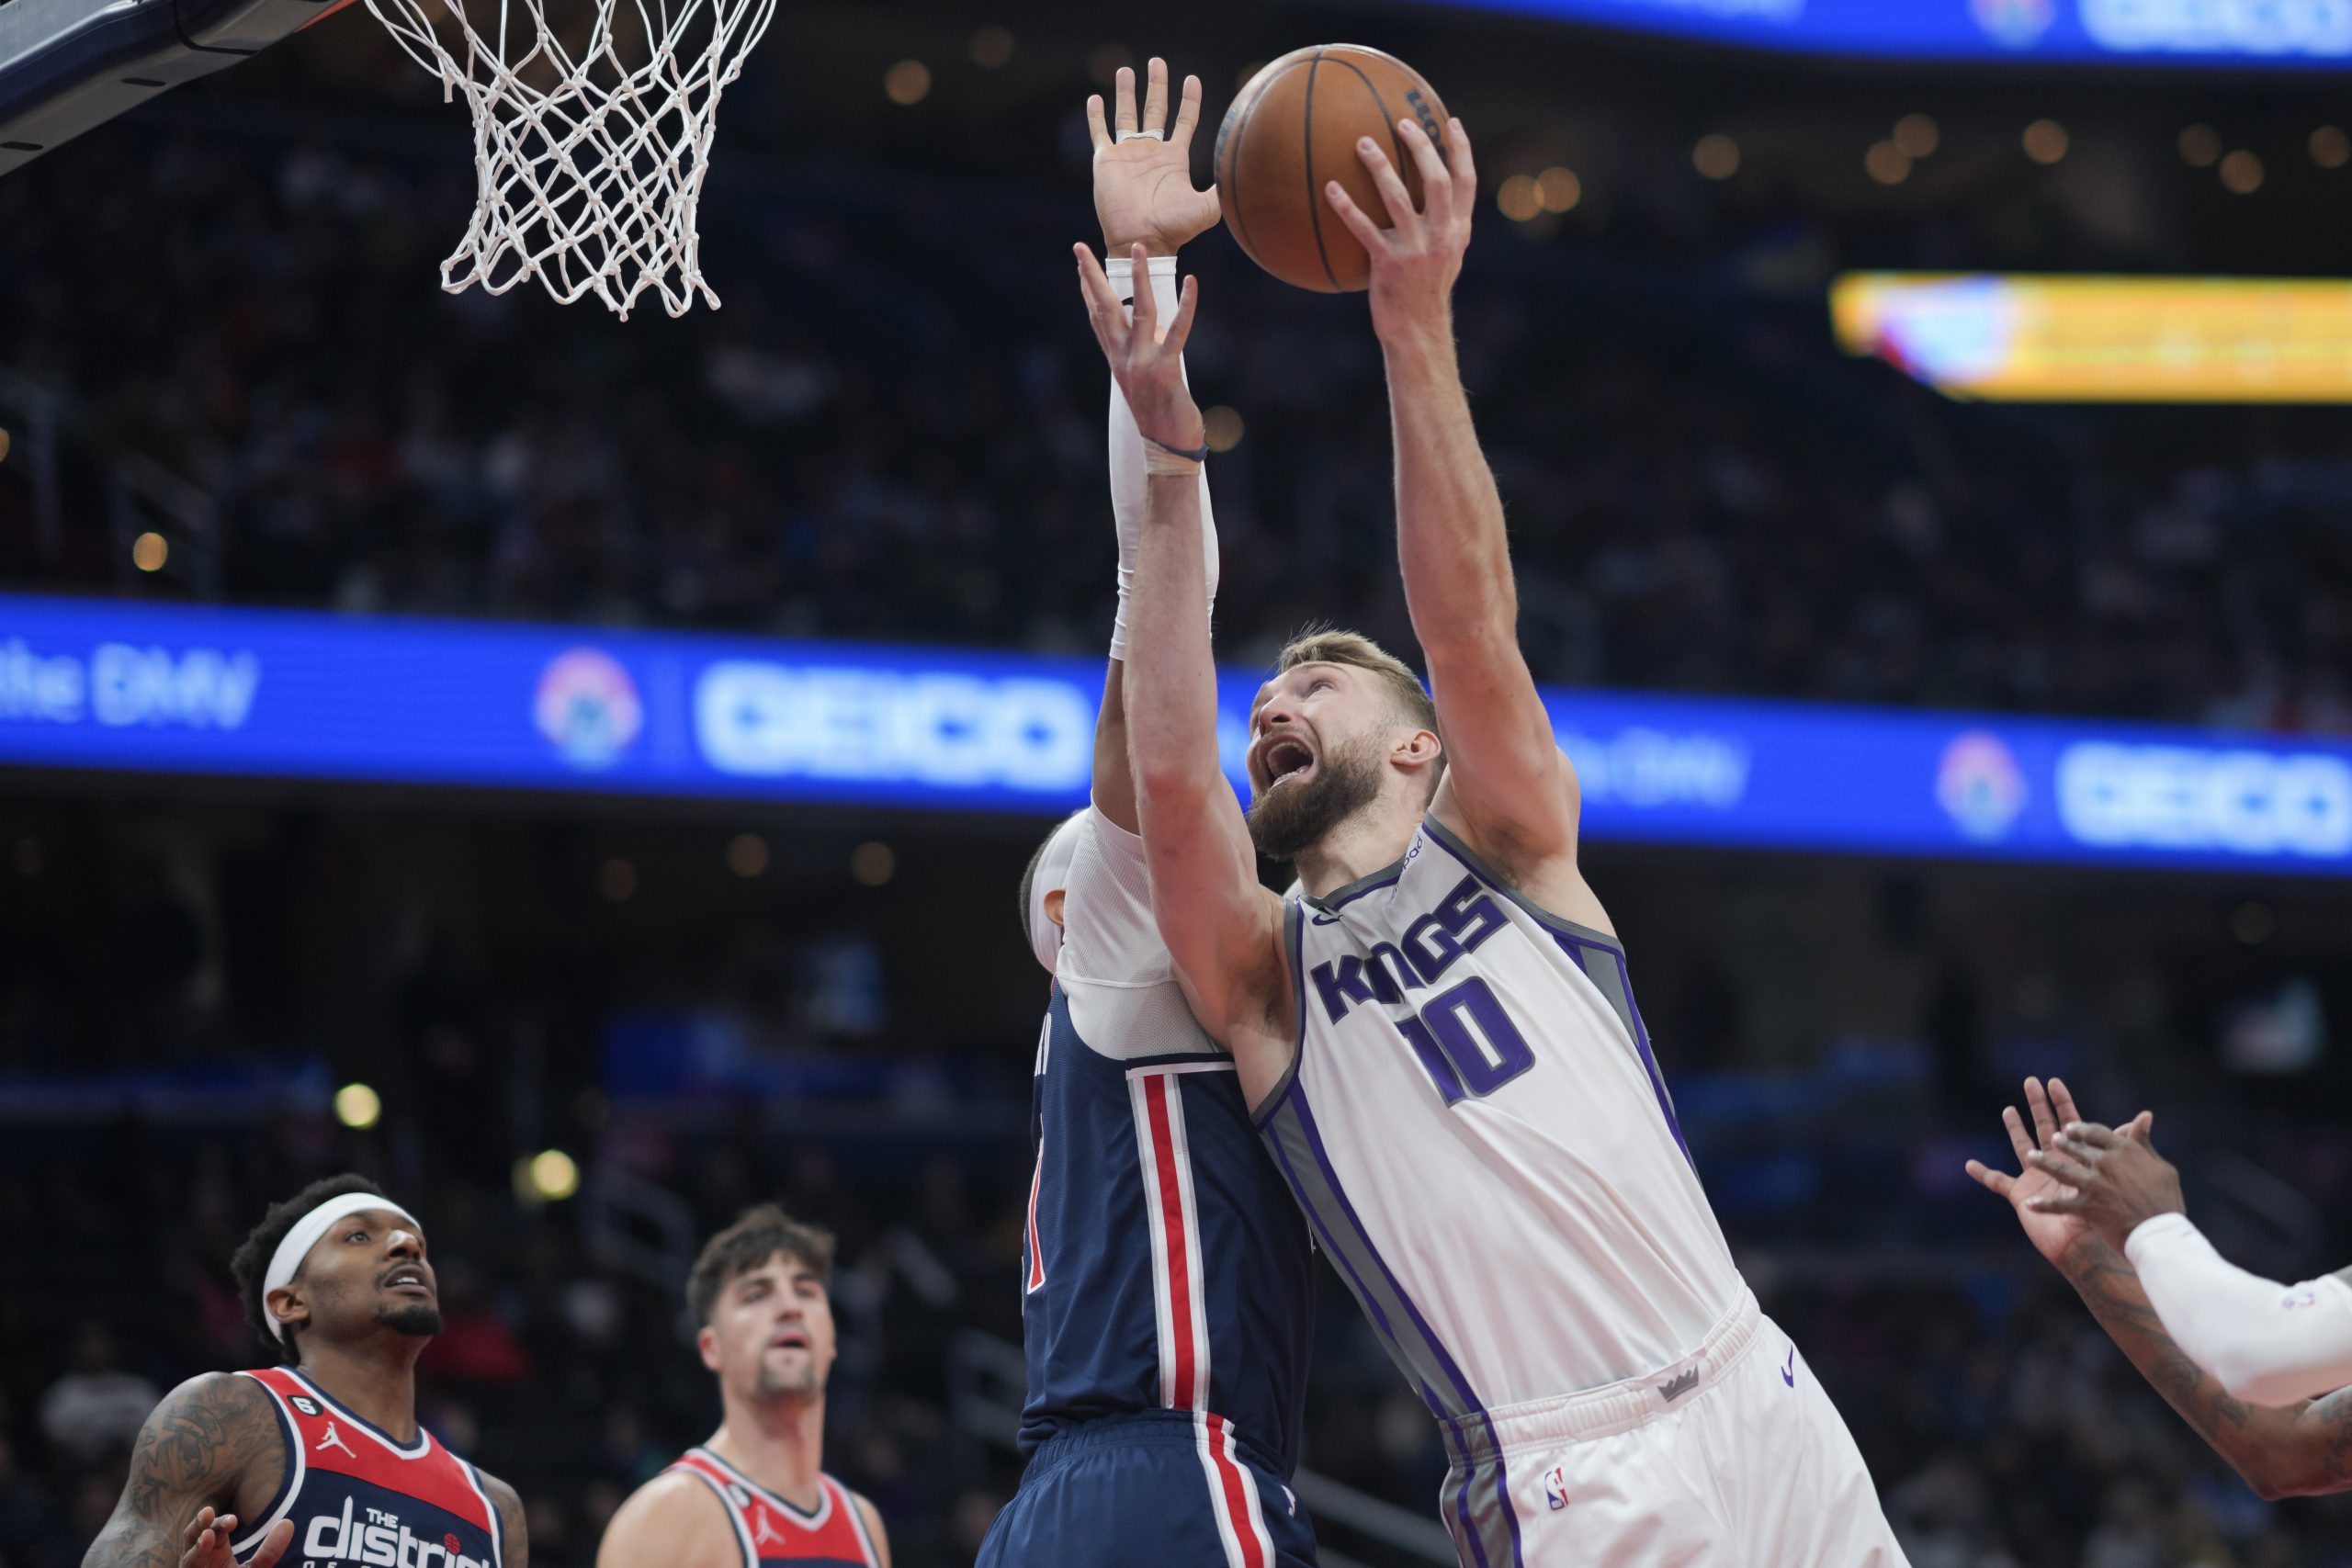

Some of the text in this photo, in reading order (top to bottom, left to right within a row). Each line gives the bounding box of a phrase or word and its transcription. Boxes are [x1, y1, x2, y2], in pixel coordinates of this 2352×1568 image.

[694, 660, 1094, 791] GEICO
[2053, 739, 2352, 857] GEICO
[1393, 976, 1536, 1109] 10
[292, 1397, 317, 1416] 6
[303, 1495, 490, 1568] distri
[366, 1507, 399, 1529] THE
